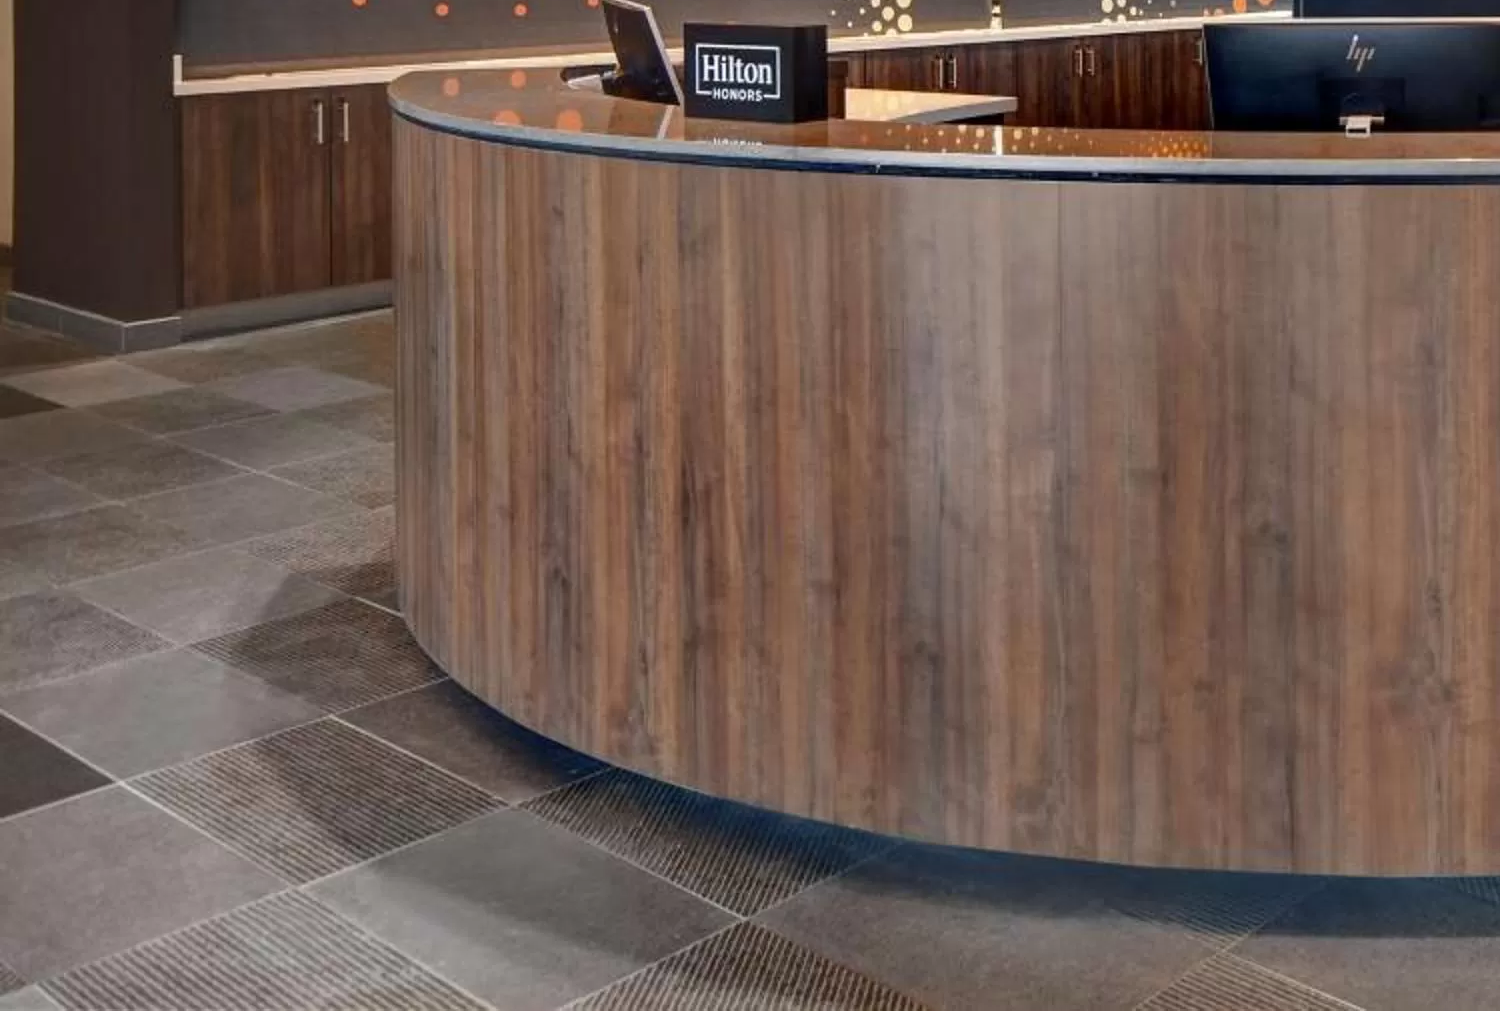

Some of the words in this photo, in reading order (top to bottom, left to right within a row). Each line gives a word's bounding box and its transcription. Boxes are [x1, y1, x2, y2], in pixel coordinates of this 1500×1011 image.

[701, 53, 774, 85] Hilton
[1345, 34, 1375, 73] hp
[712, 87, 763, 102] HONORS
